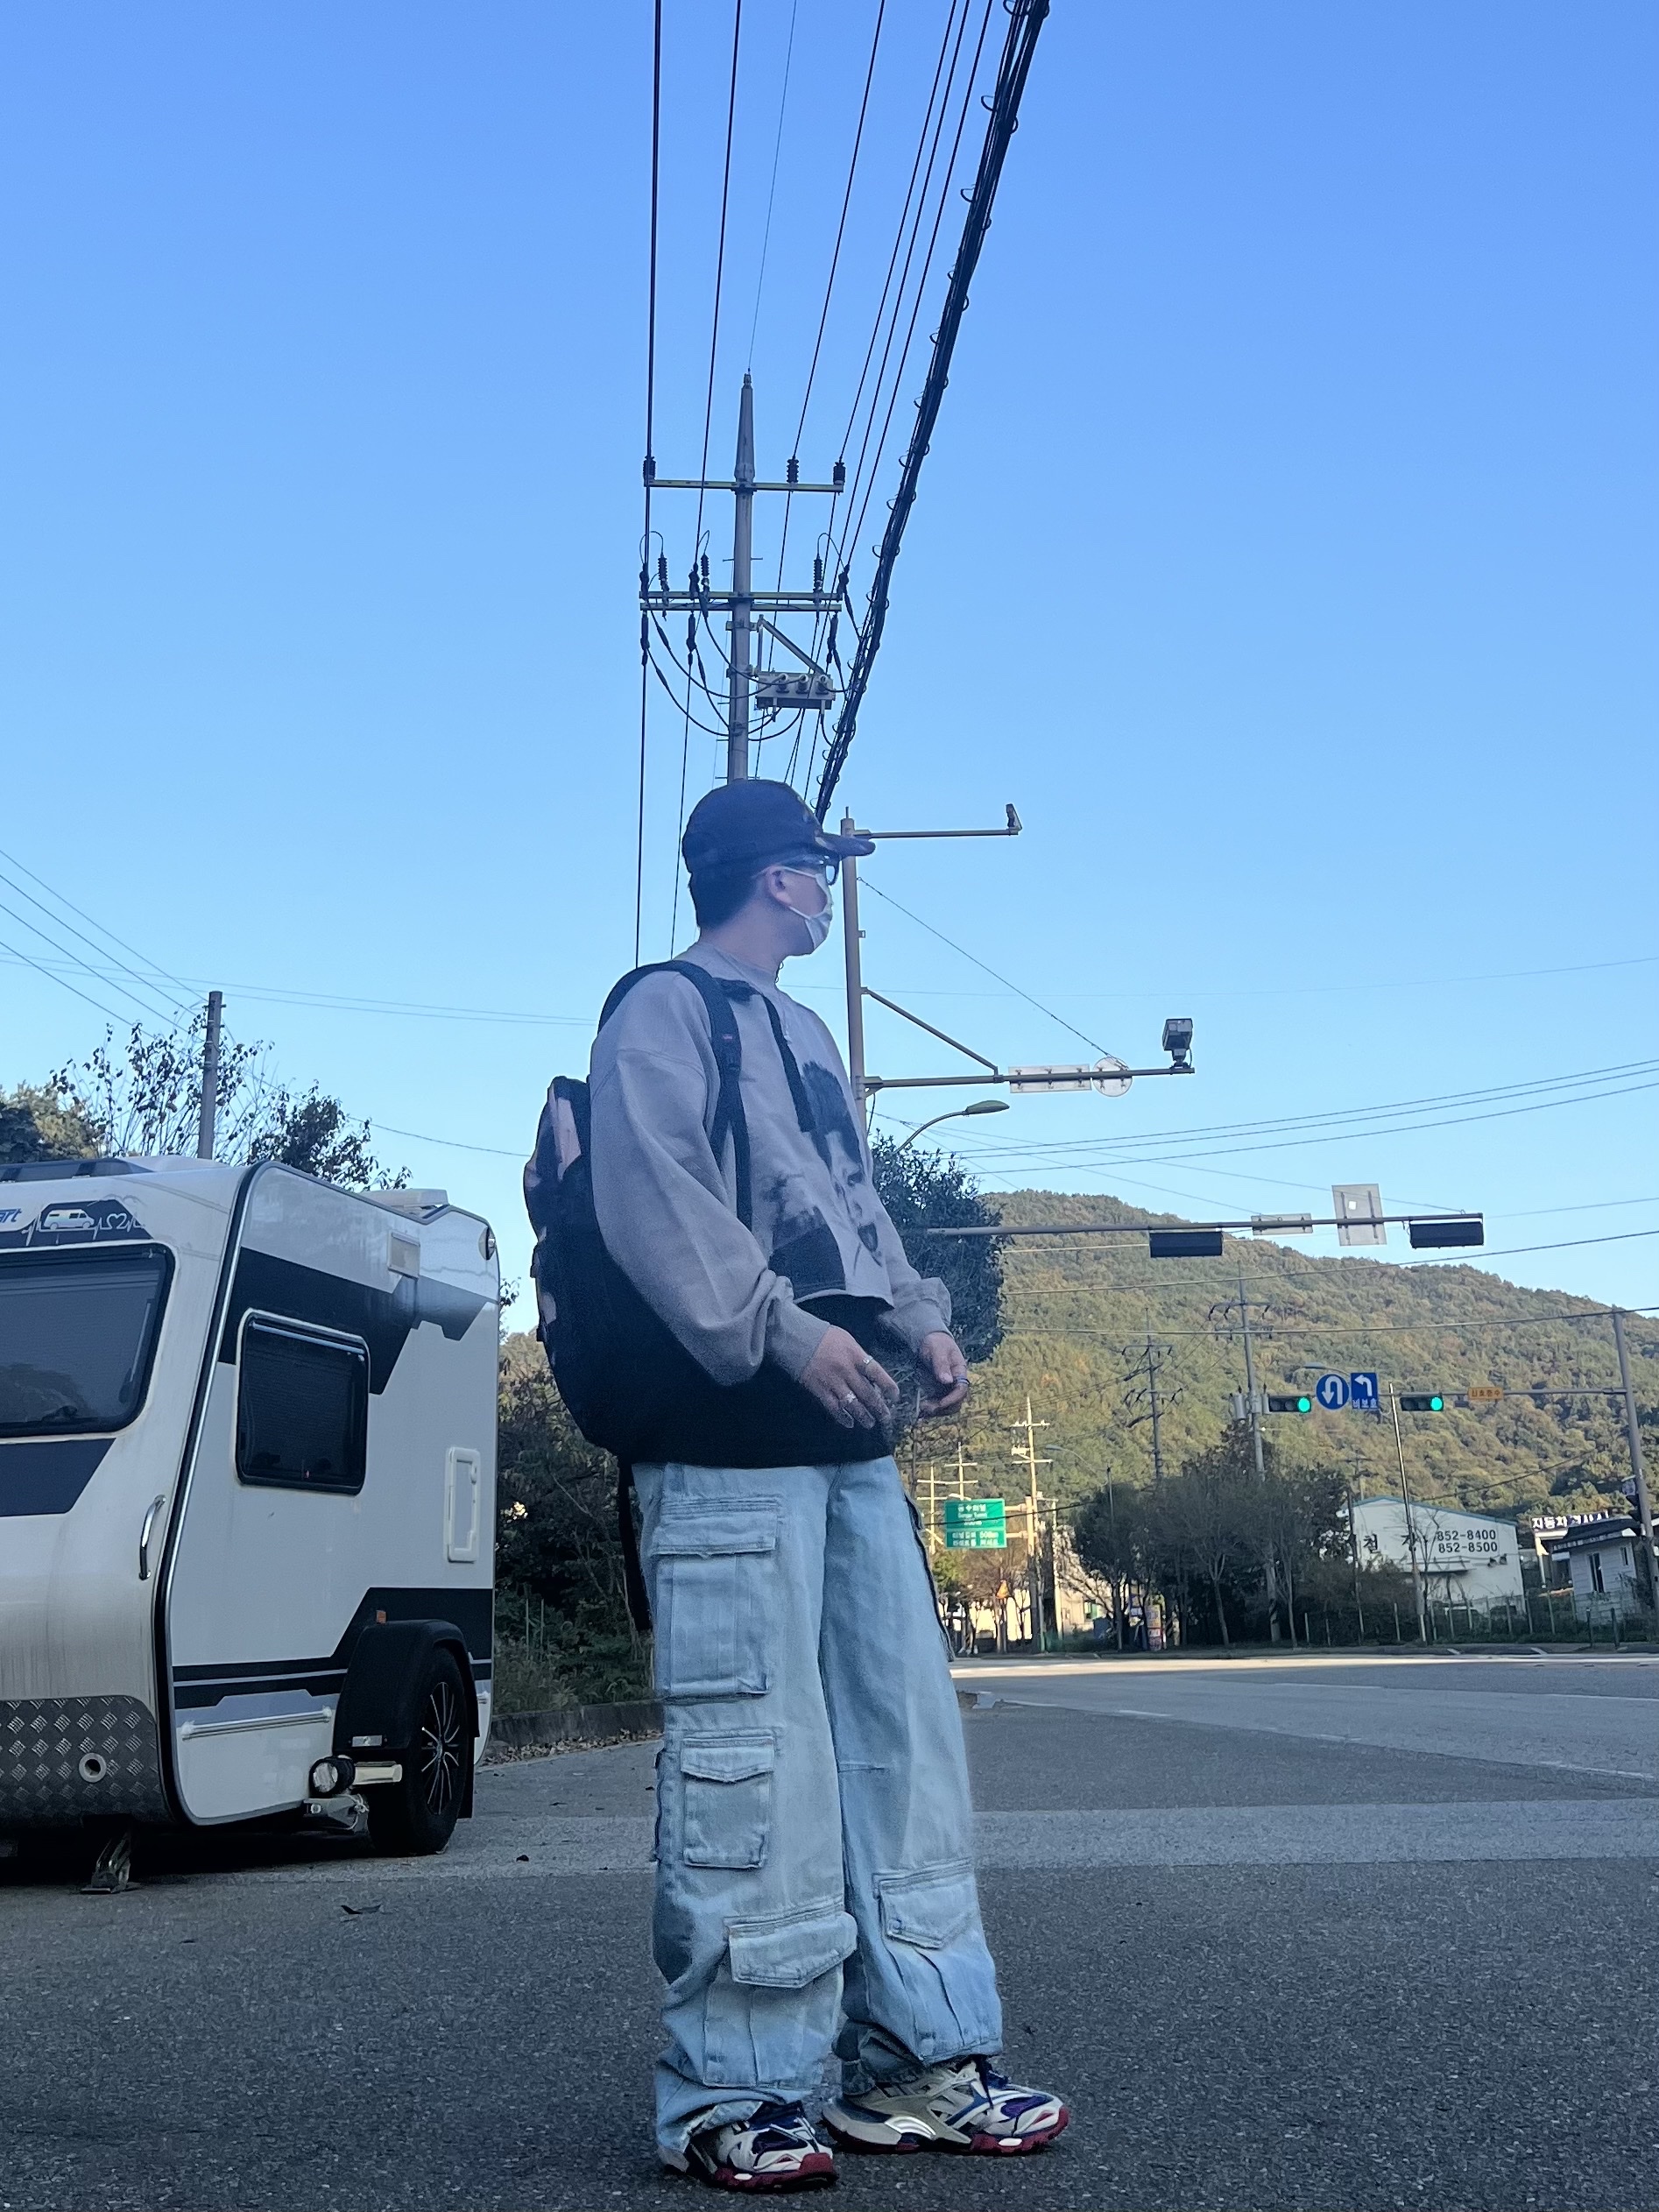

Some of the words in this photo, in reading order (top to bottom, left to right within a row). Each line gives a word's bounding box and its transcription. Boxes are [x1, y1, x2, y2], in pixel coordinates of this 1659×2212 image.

[1352, 1398, 1378, 1409] 비보호
[1437, 1529, 1497, 1542] 852-8400
[1438, 1541, 1499, 1553] 852-8500
